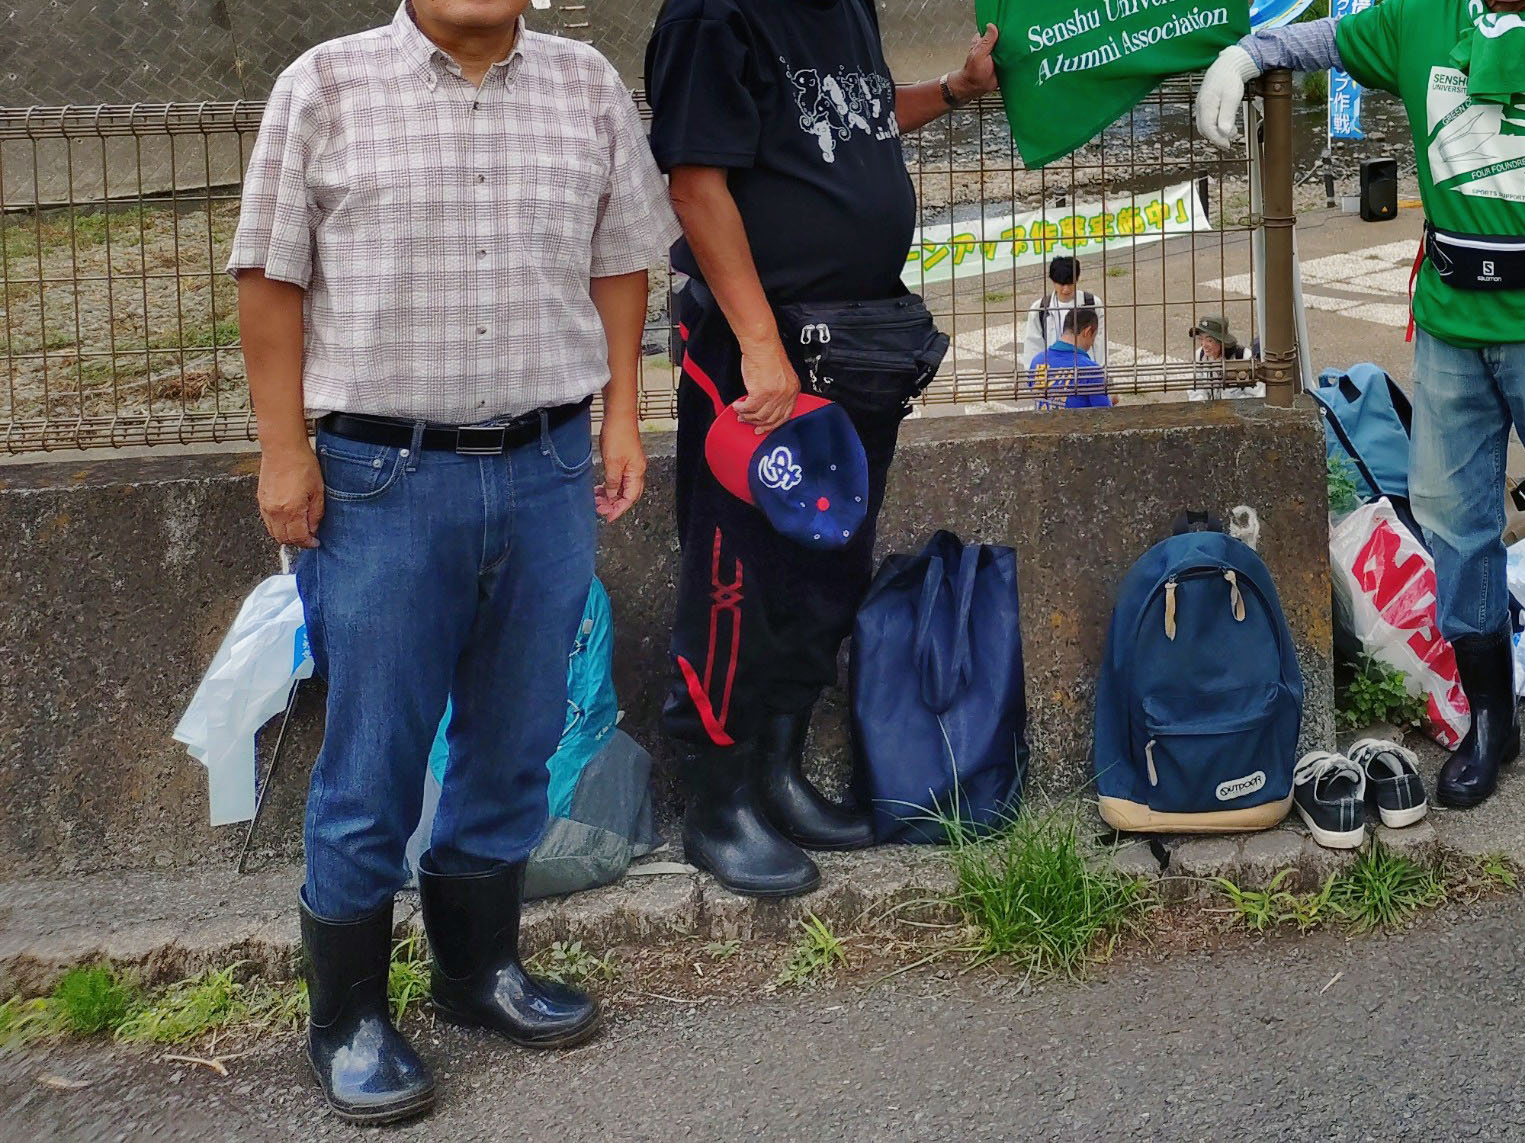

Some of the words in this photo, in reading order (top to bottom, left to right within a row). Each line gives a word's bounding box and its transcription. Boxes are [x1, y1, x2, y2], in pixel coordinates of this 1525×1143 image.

[1027, 8, 1101, 53] Senshu
[1035, 36, 1122, 87] Alumni
[1122, 6, 1229, 56] Association
[1432, 83, 1467, 94] UNIVERSIT
[1433, 73, 1468, 87] SENSH
[1220, 776, 1263, 796] OUTDOOR
